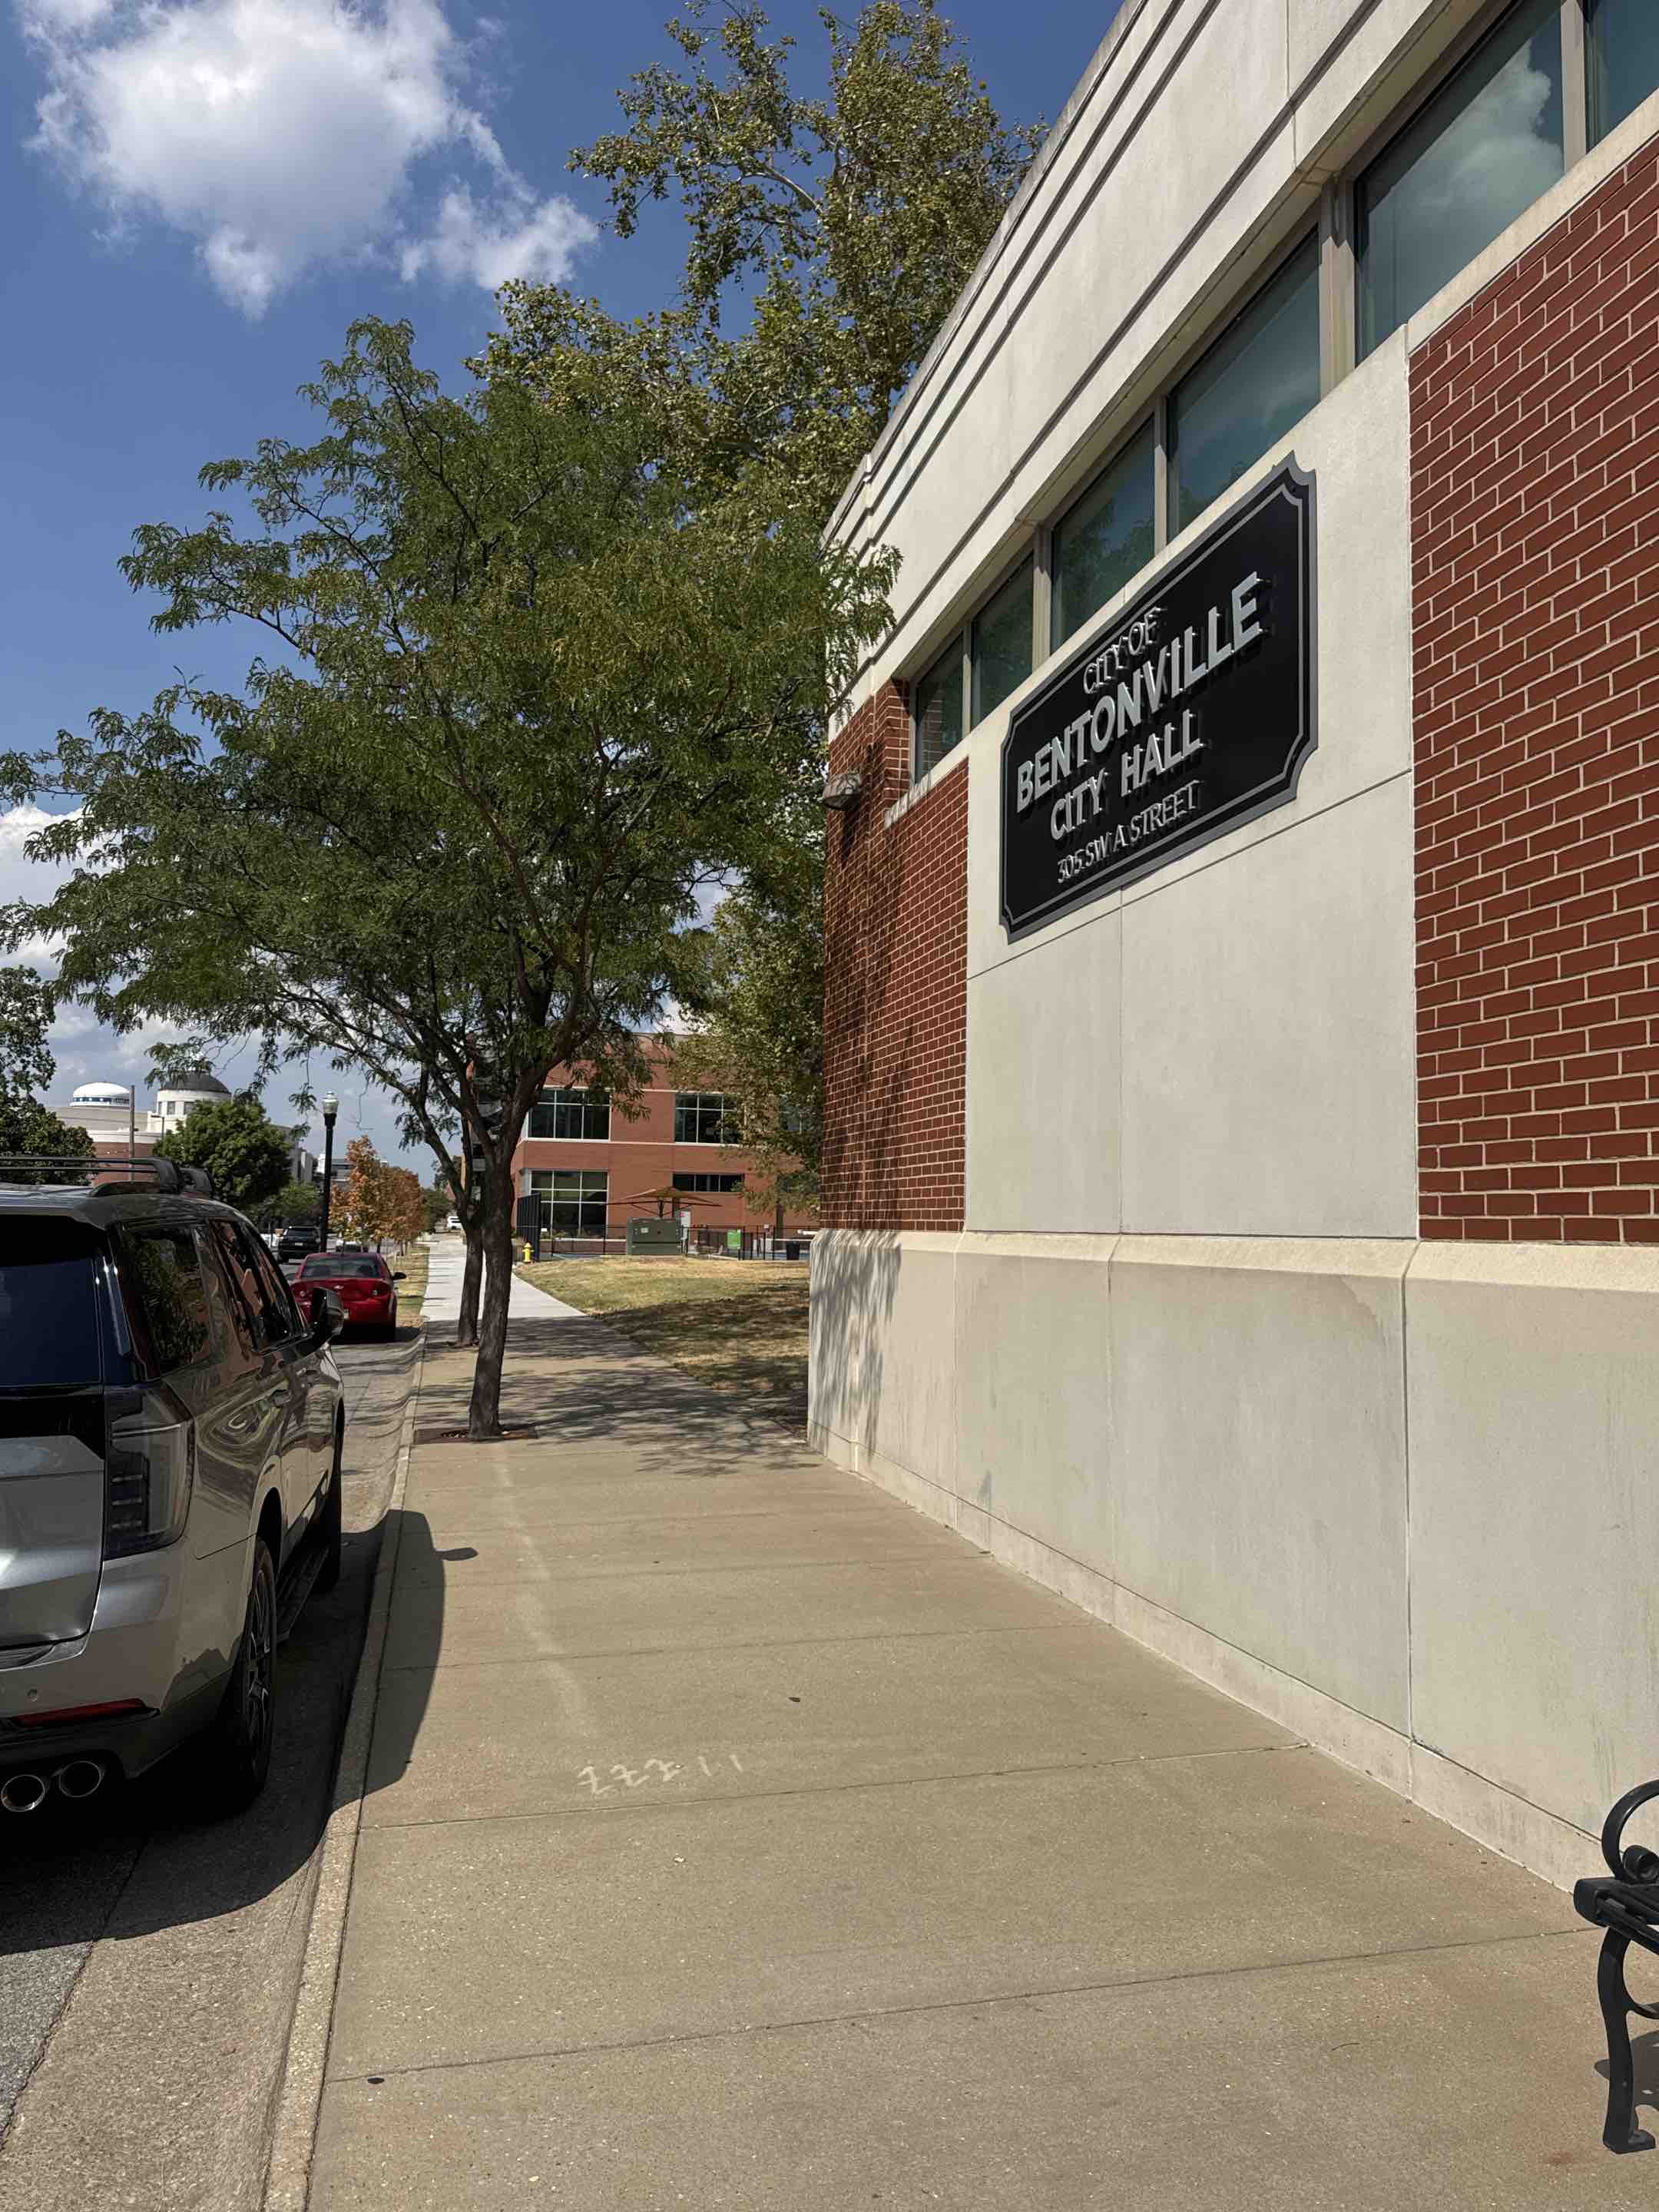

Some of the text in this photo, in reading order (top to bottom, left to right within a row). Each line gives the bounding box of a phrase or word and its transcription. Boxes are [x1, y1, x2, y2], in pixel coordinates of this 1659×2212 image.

[1017, 571, 1260, 813] BENTONVILLE
[1083, 607, 1161, 694] CITY OF
[1051, 708, 1200, 840] CITY HALL
[1058, 781, 1198, 883] 305 SW A STREET
